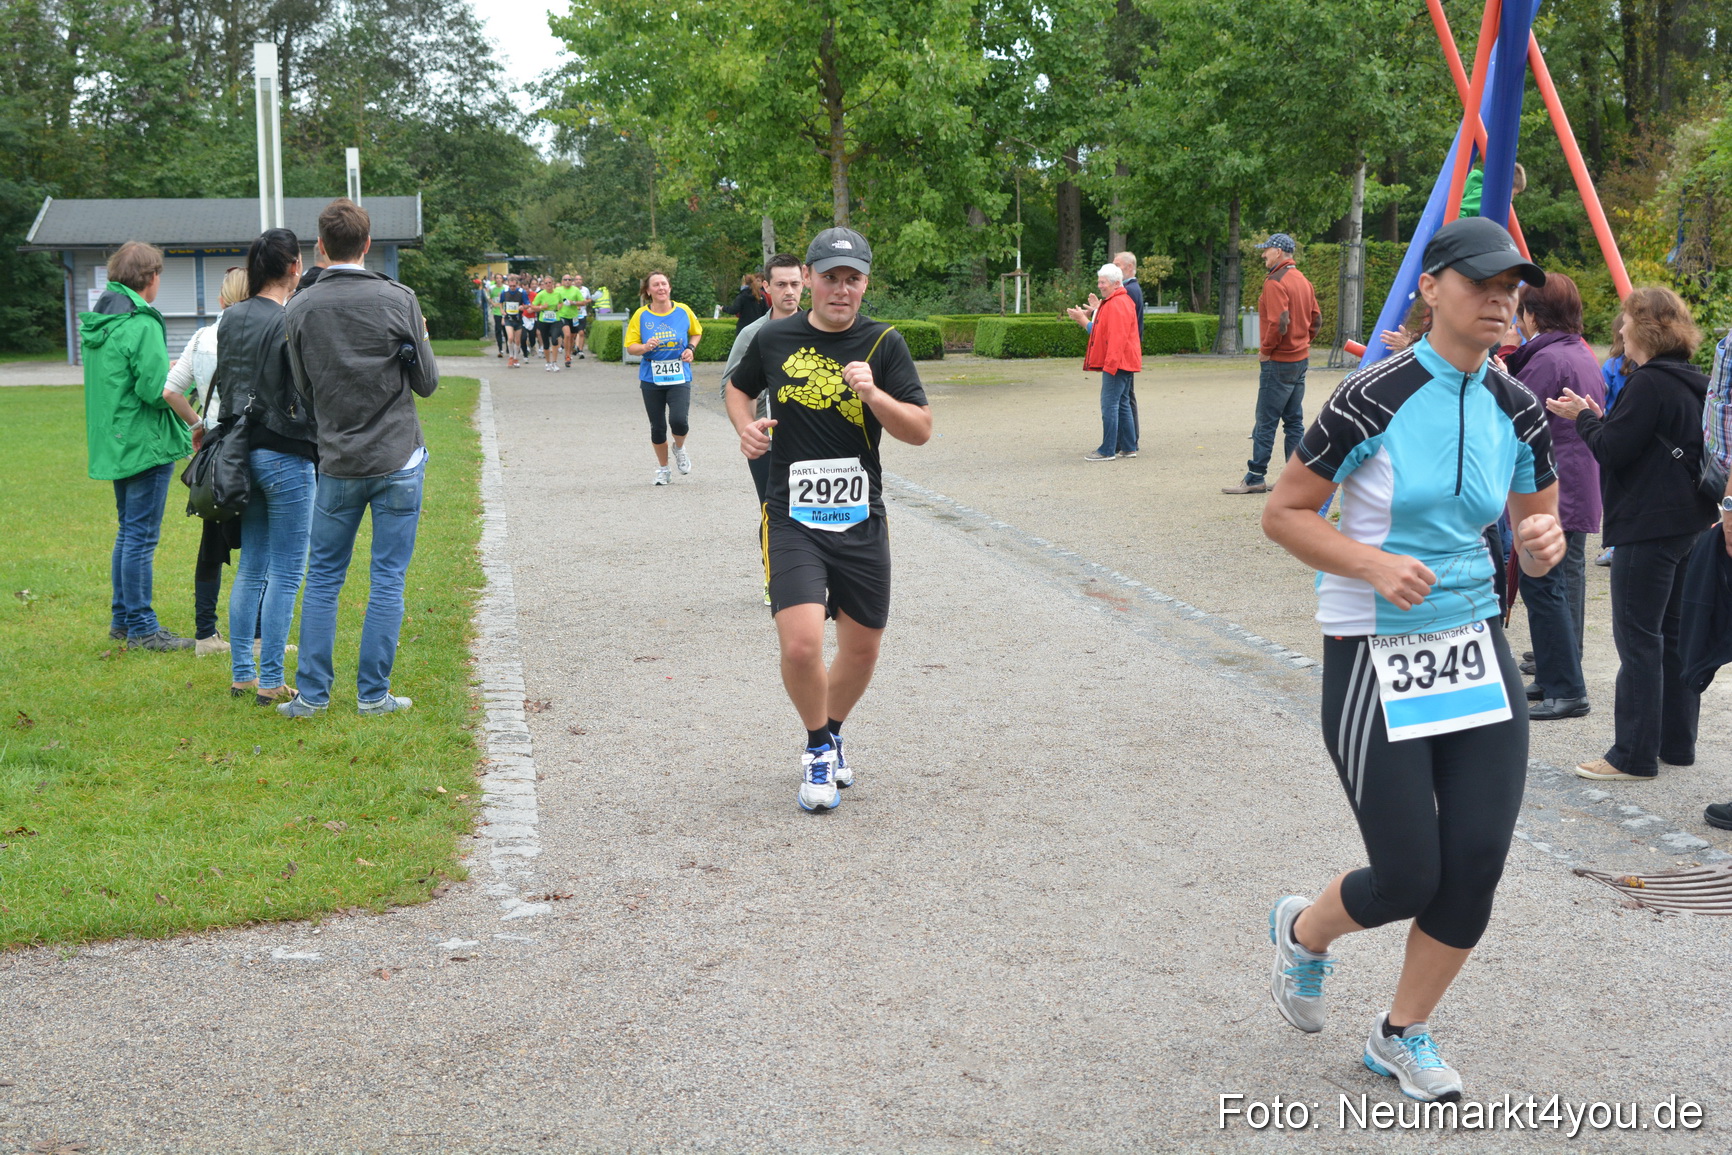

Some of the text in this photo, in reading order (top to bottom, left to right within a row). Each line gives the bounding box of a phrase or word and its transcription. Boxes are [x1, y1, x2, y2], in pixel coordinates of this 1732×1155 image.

[655, 362, 681, 375] 2443
[792, 465, 858, 476] PARTL Neumarkt
[798, 475, 863, 504] 2920
[812, 510, 851, 521] Markus
[1372, 625, 1470, 650] PARTL Neumarkt
[1387, 640, 1486, 693] 3349
